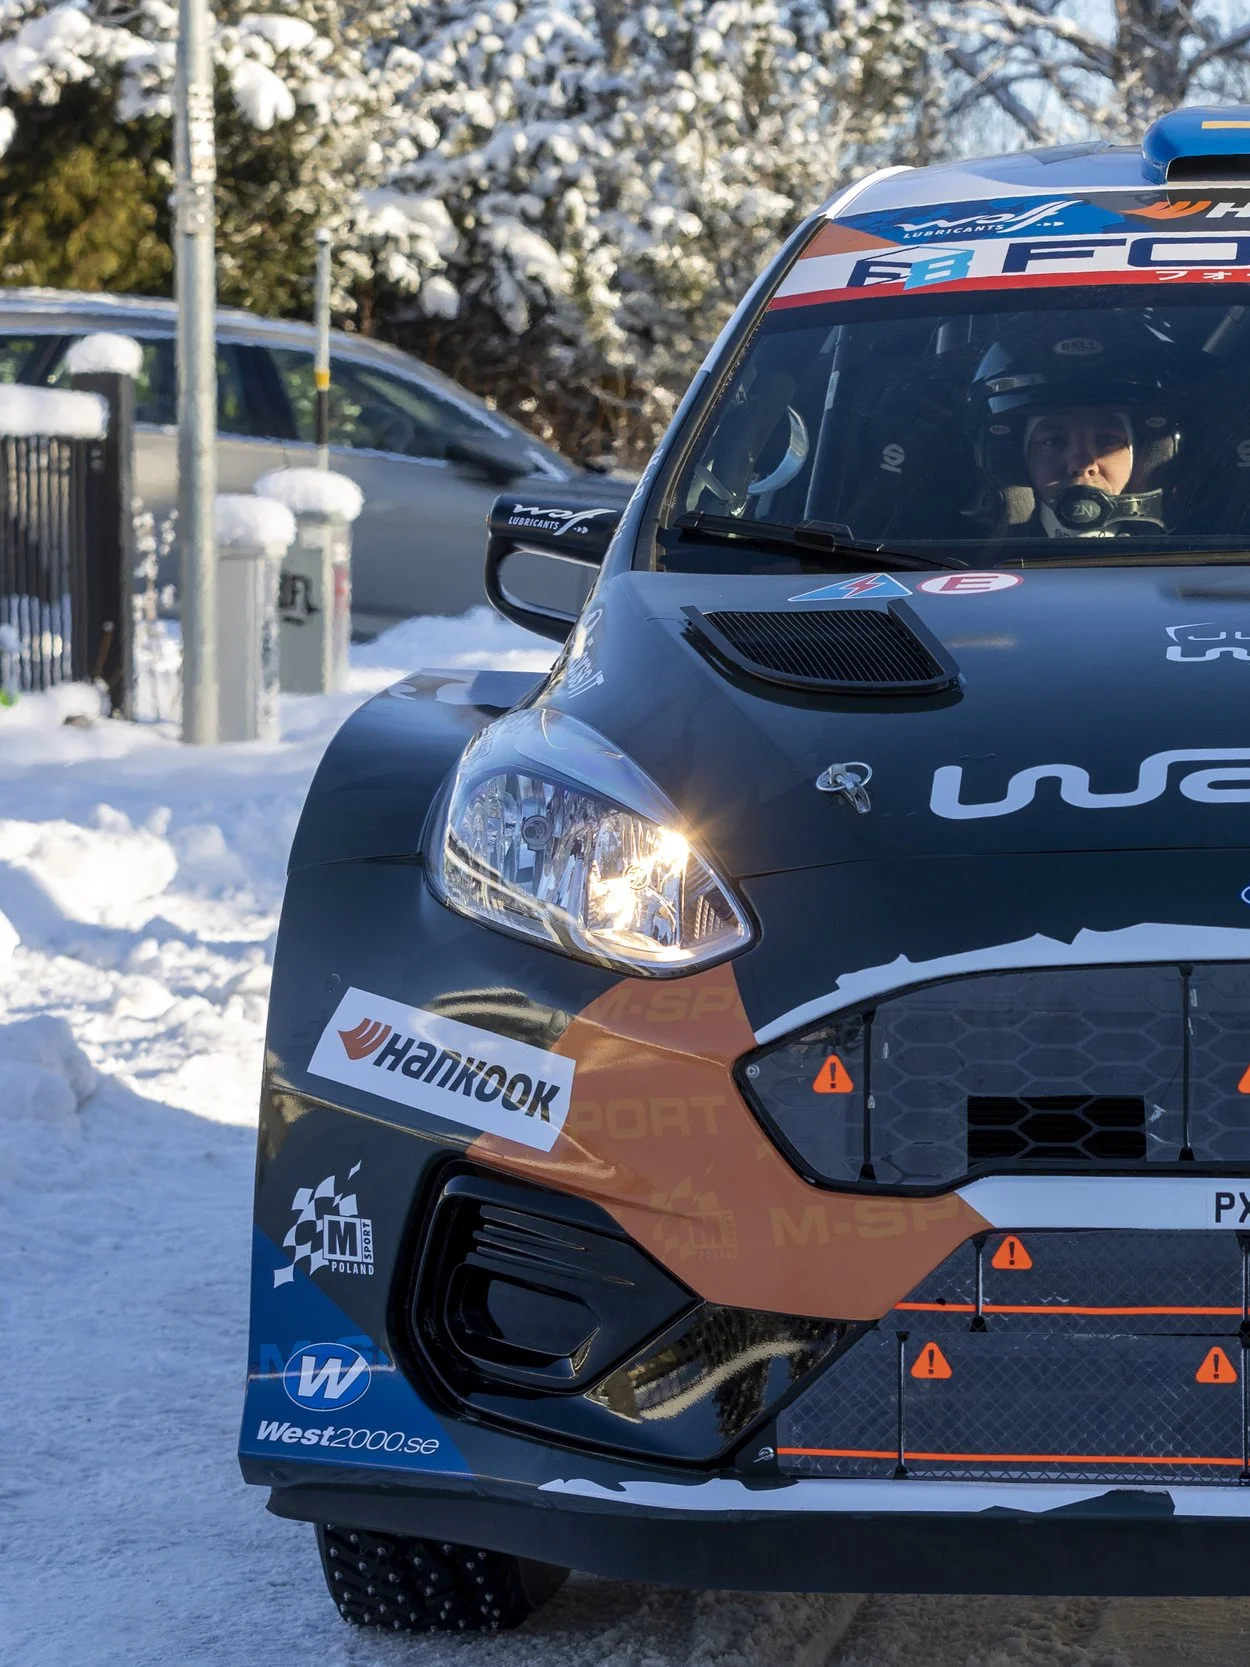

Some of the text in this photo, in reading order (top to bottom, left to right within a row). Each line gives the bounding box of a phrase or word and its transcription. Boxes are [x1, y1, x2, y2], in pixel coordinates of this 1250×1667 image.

[903, 224, 1005, 239] LUBRICANTS
[508, 516, 561, 530] LUBRICANTS
[940, 574, 999, 592] E
[328, 1219, 358, 1257] M
[362, 1221, 373, 1260] SPORT
[331, 1261, 375, 1276] POLAND
[297, 1355, 369, 1400] W
[256, 1420, 440, 1455] West2000.se
